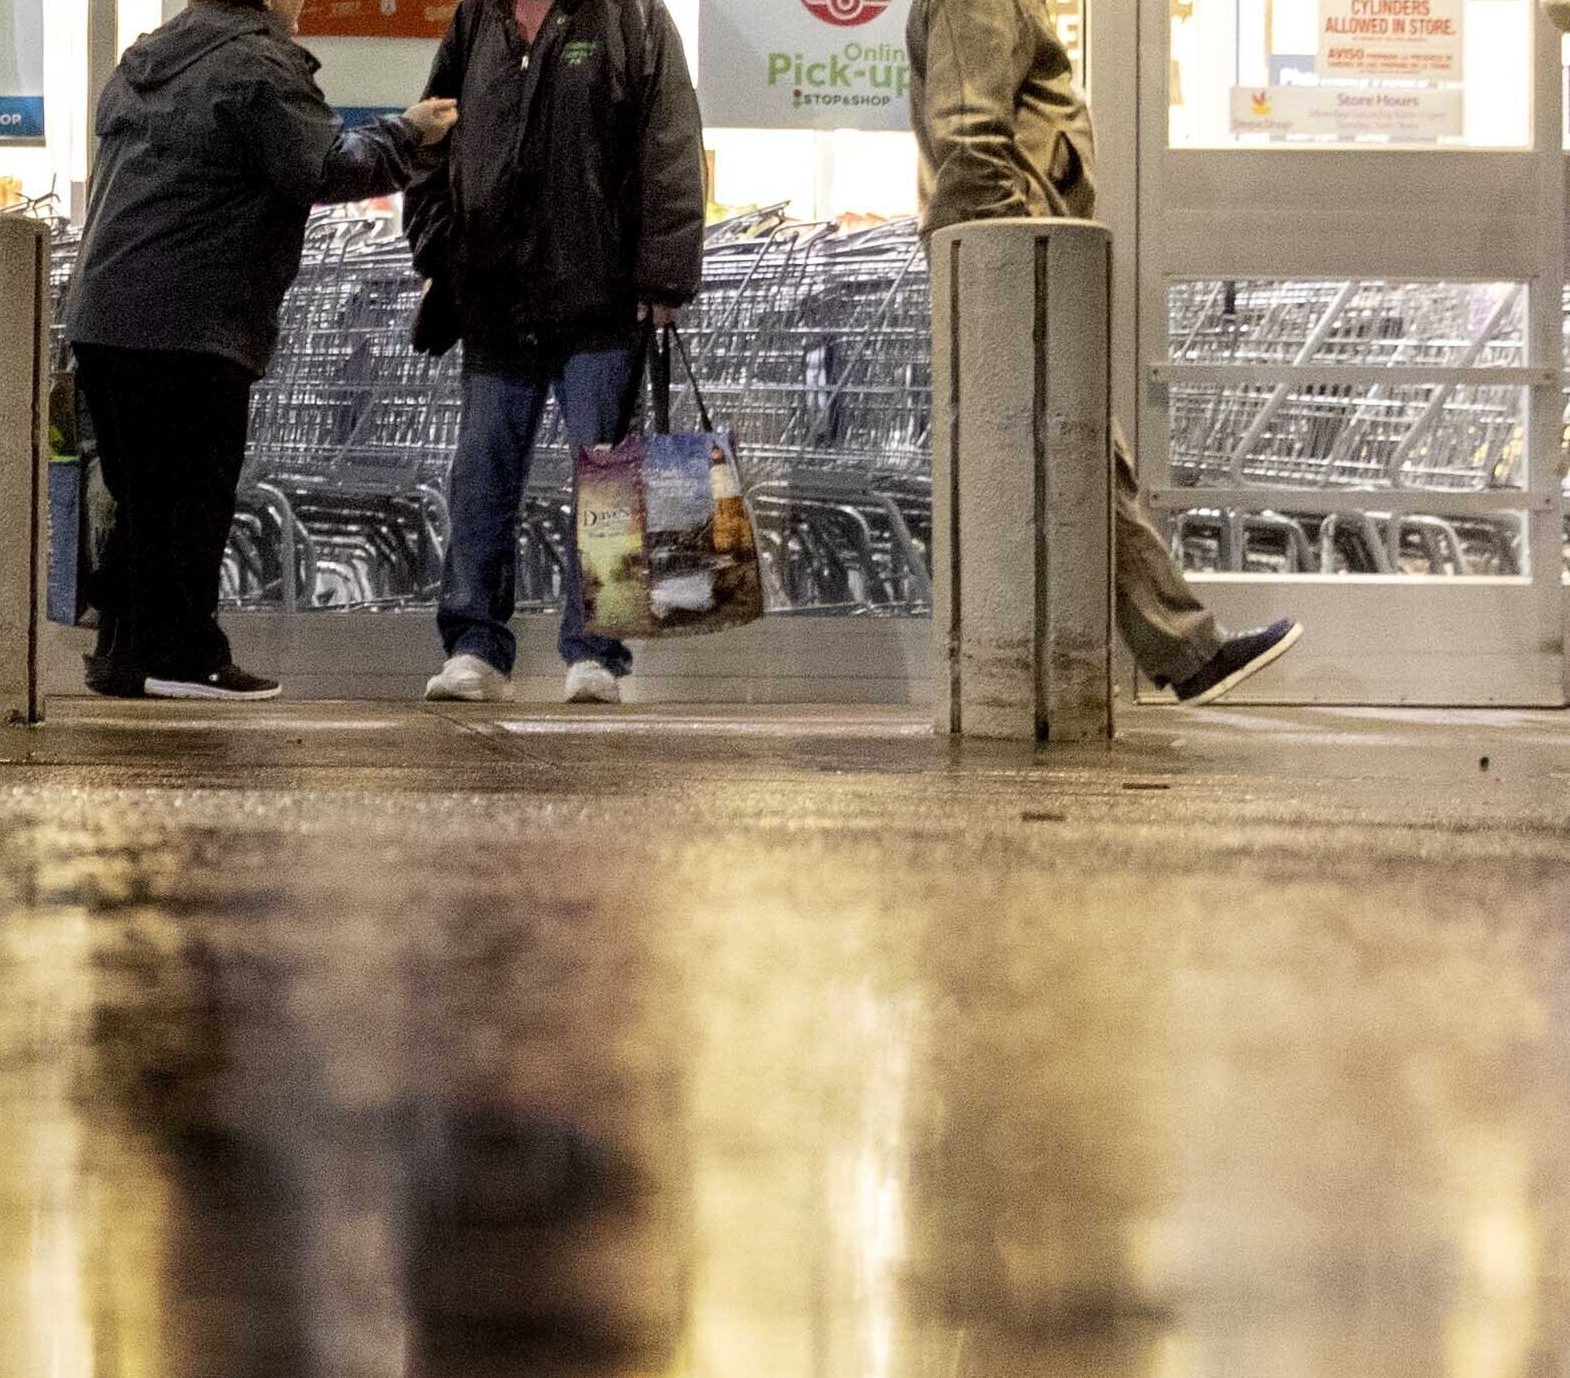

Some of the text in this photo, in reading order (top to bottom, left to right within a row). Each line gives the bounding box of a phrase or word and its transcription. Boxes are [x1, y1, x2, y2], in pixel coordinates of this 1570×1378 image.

[1351, 0, 1431, 15] CYLINDERS
[1324, 17, 1455, 35] ALLOWED IN STORE.
[844, 42, 906, 62] Onlin
[1328, 48, 1365, 59] AVISO
[1337, 93, 1419, 107] Store Hours
